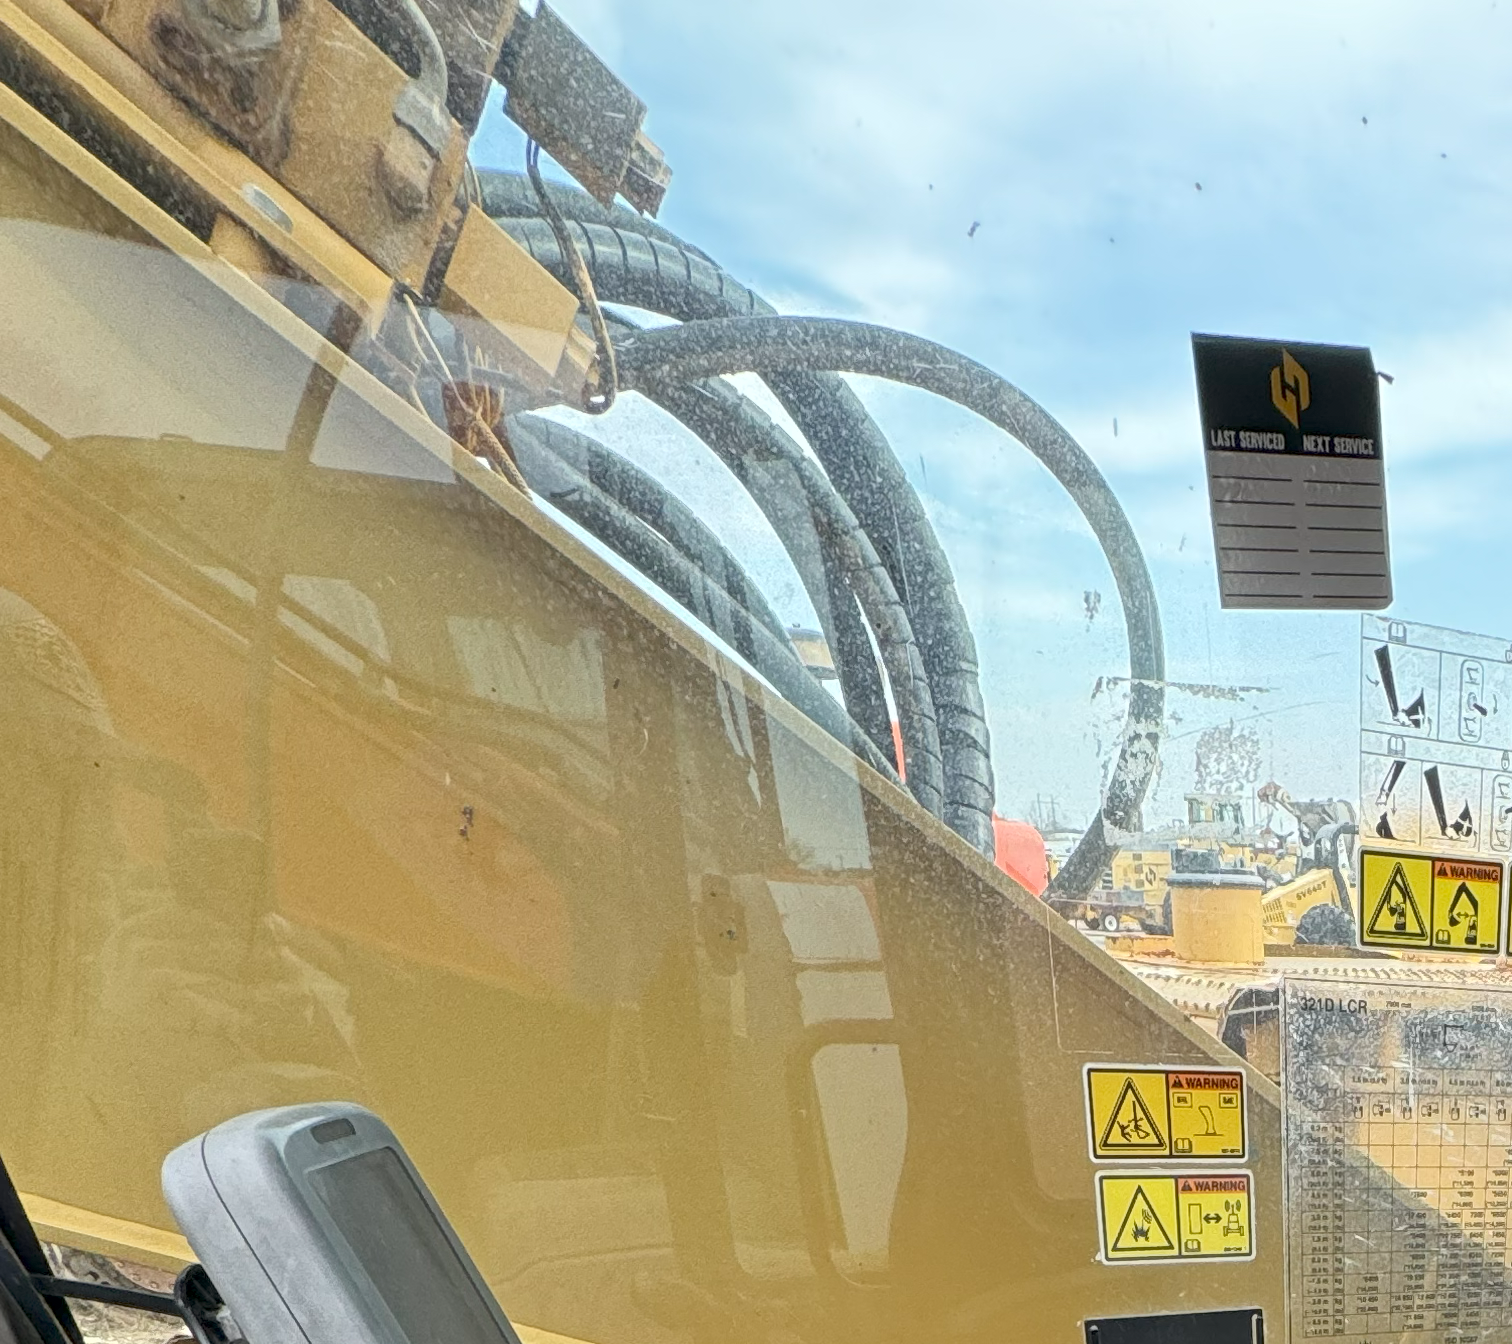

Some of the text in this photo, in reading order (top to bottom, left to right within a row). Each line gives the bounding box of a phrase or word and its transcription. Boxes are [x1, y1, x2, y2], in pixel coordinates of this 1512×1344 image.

[1210, 429, 1286, 450] LAST SERVICED
[1303, 434, 1375, 455] NEXT SERVICE
[1450, 865, 1499, 881] WARNING
[1300, 996, 1335, 1013] 321D
[1339, 997, 1368, 1014] LCR
[1185, 1077, 1239, 1089] WARNING
[1194, 1180, 1246, 1192] WARNING
